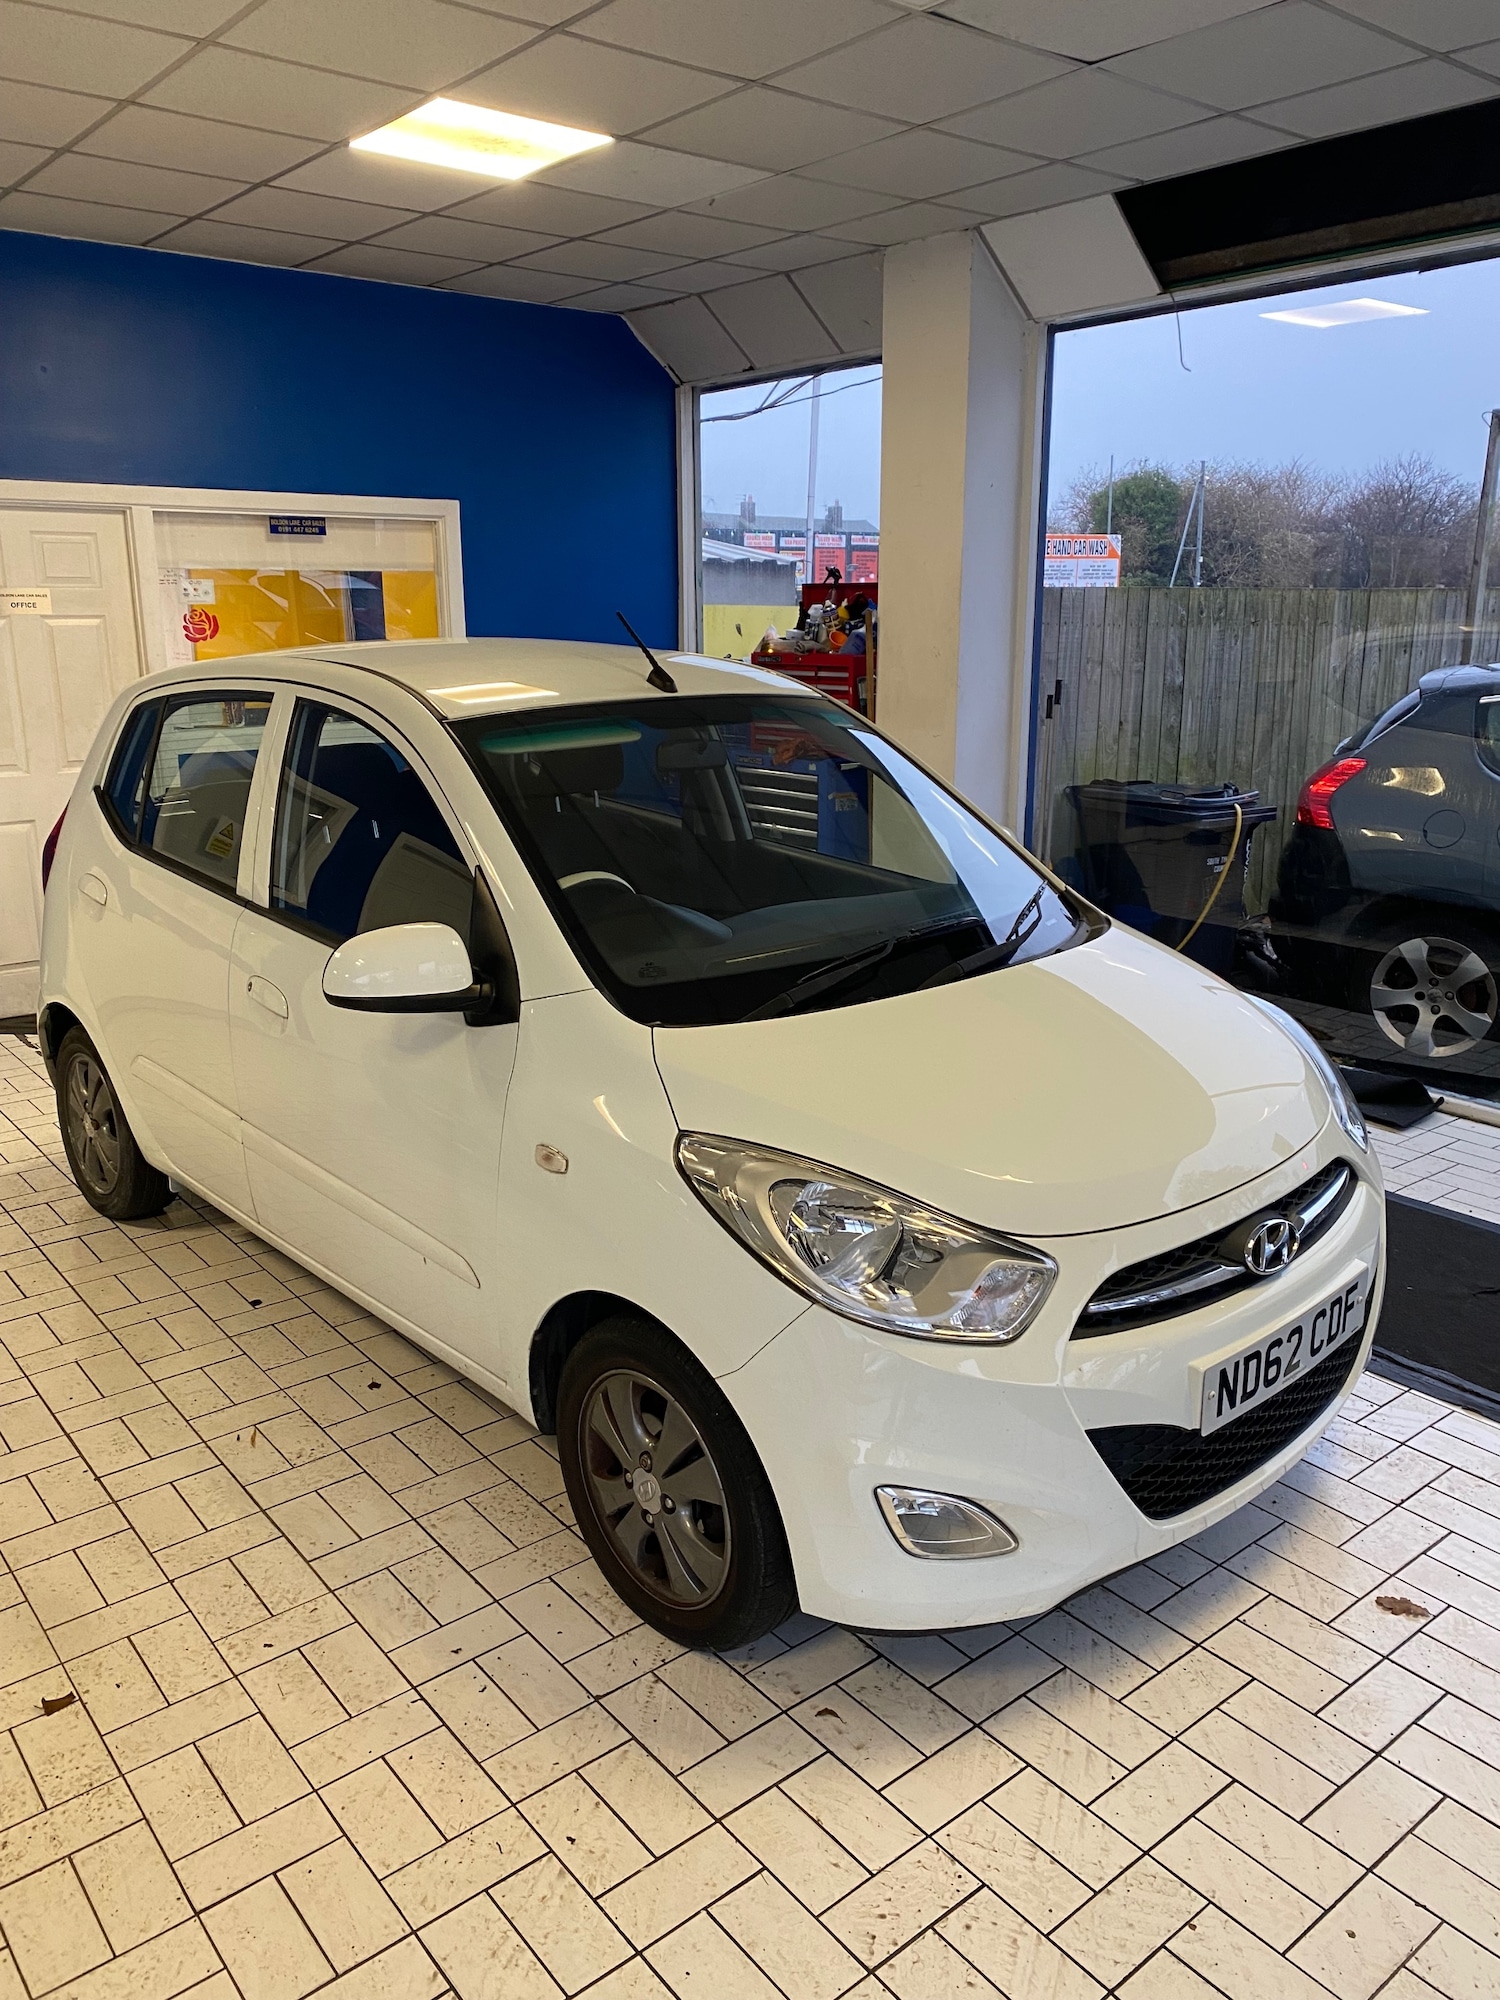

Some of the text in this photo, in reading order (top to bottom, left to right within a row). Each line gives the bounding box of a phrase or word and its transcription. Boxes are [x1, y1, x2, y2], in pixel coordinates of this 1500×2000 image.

[1053, 540, 1072, 555] HAND
[1073, 540, 1087, 555] CAR
[1088, 540, 1108, 555] WASH
[1216, 1281, 1359, 1418] ND62 CDF
